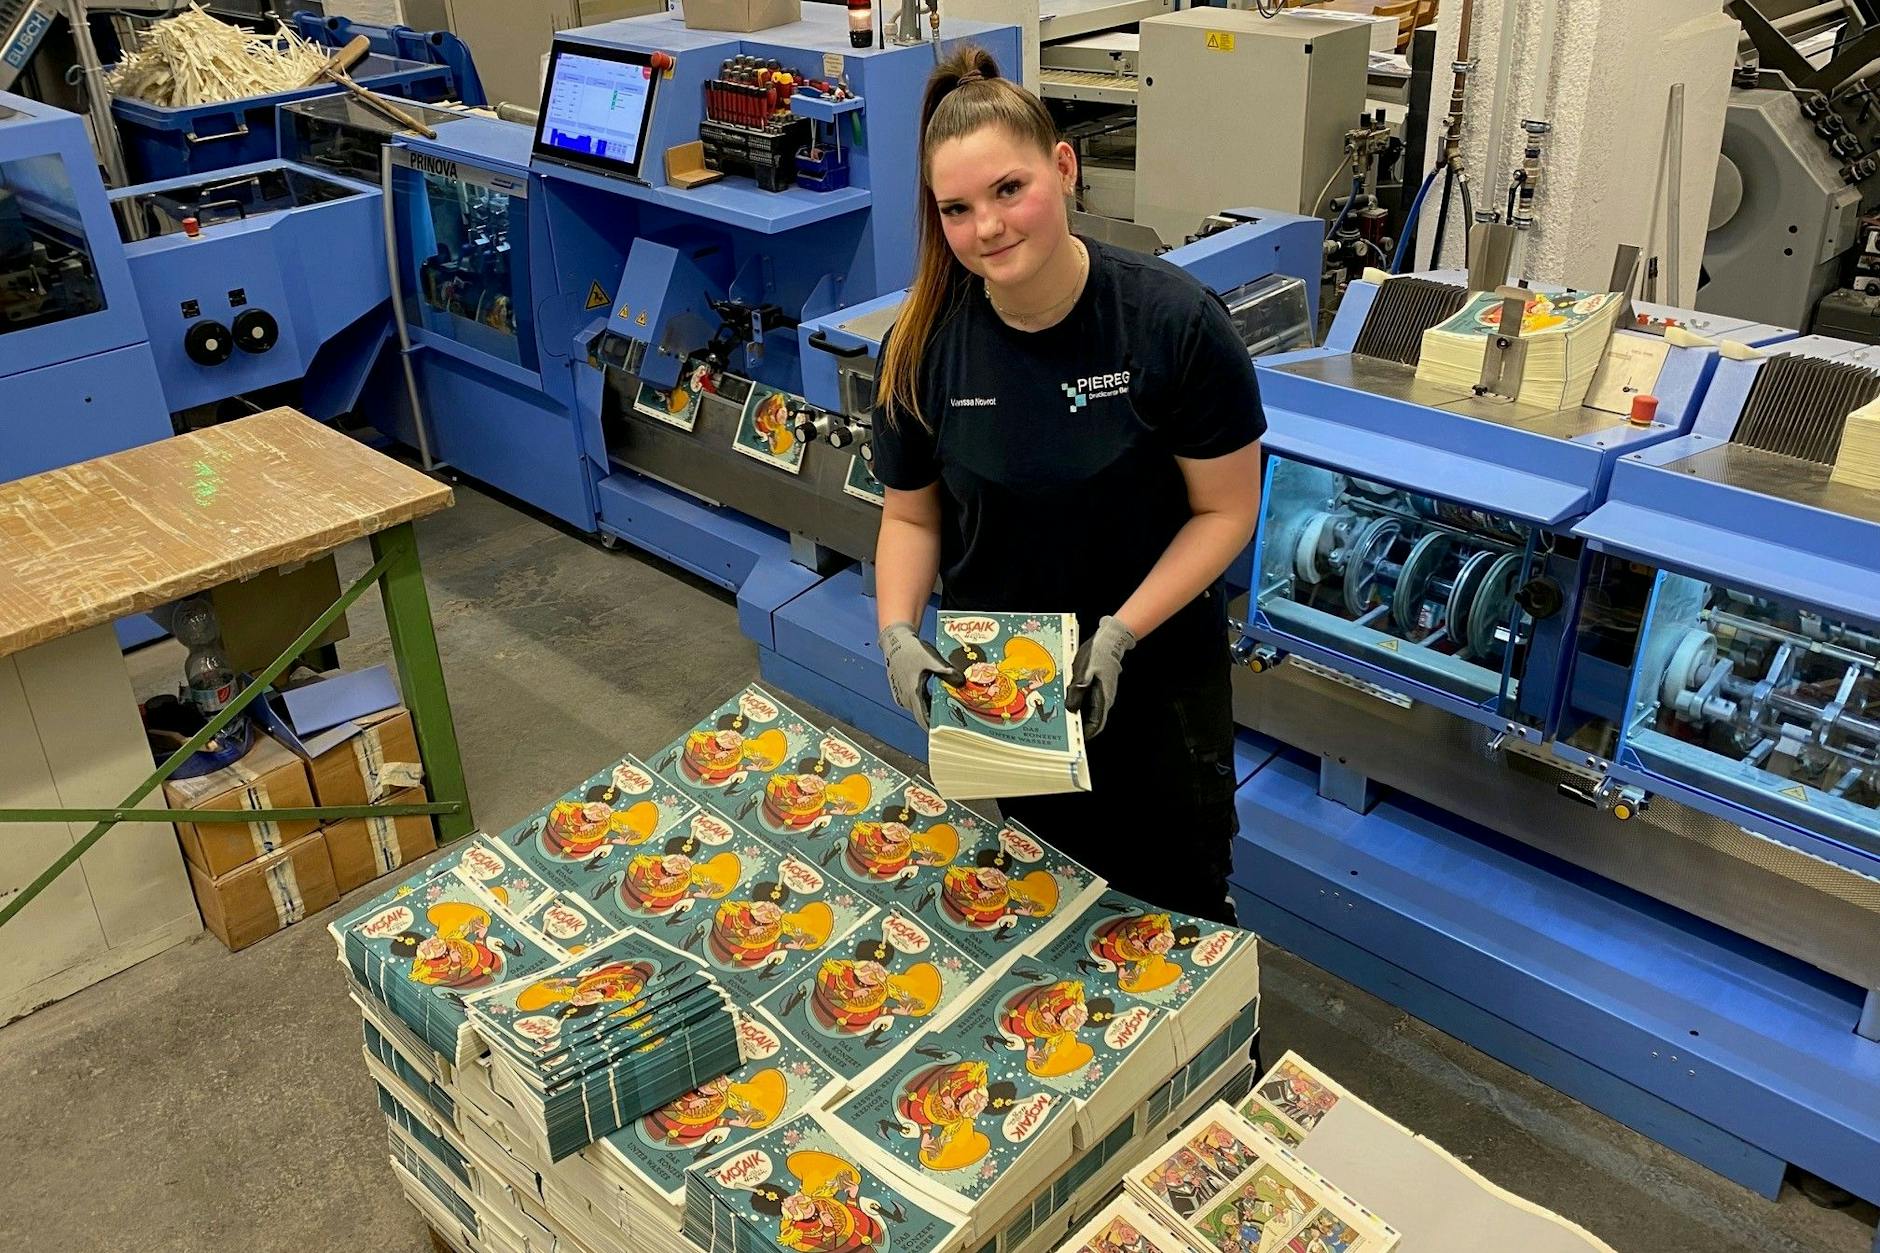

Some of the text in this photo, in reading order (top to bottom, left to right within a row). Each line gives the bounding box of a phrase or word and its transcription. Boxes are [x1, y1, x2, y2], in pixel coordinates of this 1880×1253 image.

[7, 14, 47, 65] BUSCH
[410, 153, 459, 179] PRINOVA
[1077, 371, 1131, 393] PIEREG
[948, 621, 996, 634] MOSAIK
[743, 693, 777, 717] MOSAIK
[988, 729, 1017, 740] UNTER
[1023, 732, 1063, 741] KONZERT
[823, 737, 858, 762] MOSAIK
[617, 764, 649, 789] MOSAIK
[908, 787, 945, 812] MOSAIK
[696, 815, 731, 840] MOSAIK
[1002, 829, 1041, 857] MOSAIK
[467, 848, 503, 874] MOSAIK
[783, 861, 821, 889] MOSAIK
[366, 907, 409, 935] MOSAIK
[547, 908, 586, 931] MOSAIK
[886, 918, 928, 948] MOSAIK
[1200, 932, 1231, 965] MOSAIK
[1112, 1009, 1147, 1048] MOSAIK
[1010, 1095, 1048, 1140] MOSAIK
[666, 1153, 681, 1165] DAS
[720, 1152, 767, 1184] MOSAIK
[893, 1232, 911, 1246] DAS
[901, 1222, 936, 1251] KONZERT
